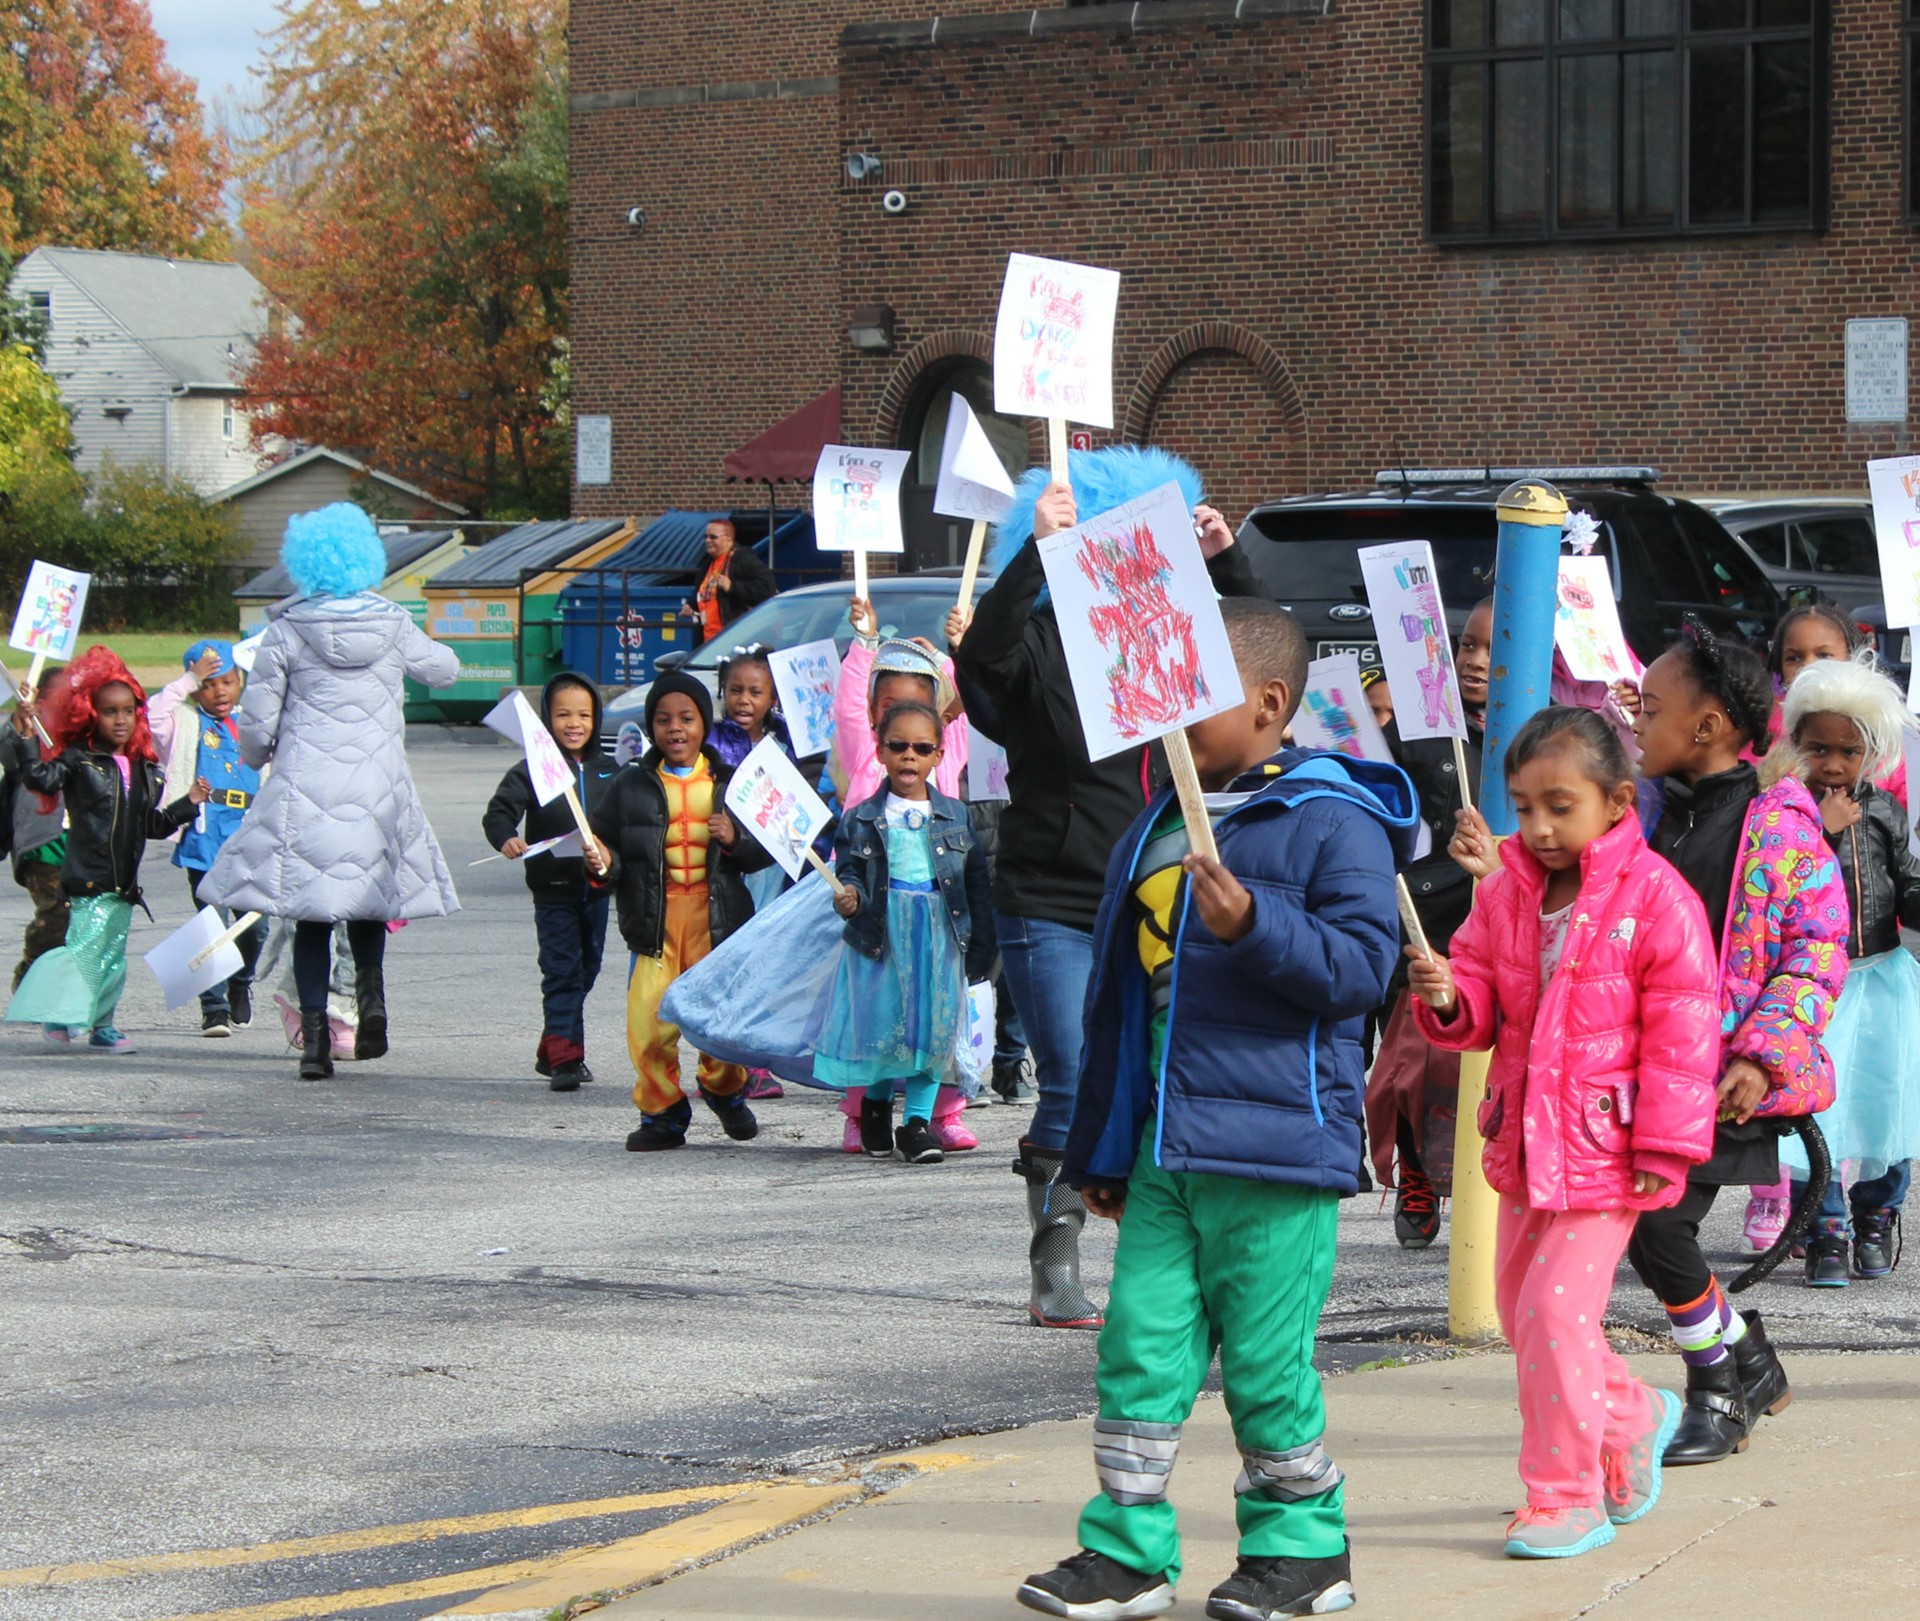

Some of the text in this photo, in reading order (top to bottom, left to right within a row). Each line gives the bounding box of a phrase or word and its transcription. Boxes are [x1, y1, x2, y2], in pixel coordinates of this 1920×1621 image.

[838, 453, 865, 467] I'm
[830, 478, 874, 499] Drug
[1392, 557, 1430, 591] I'm
[486, 603, 507, 618] PAPER
[1337, 607, 1361, 617] Ford
[479, 619, 515, 634] RECYCLING
[736, 779, 754, 804] I'm
